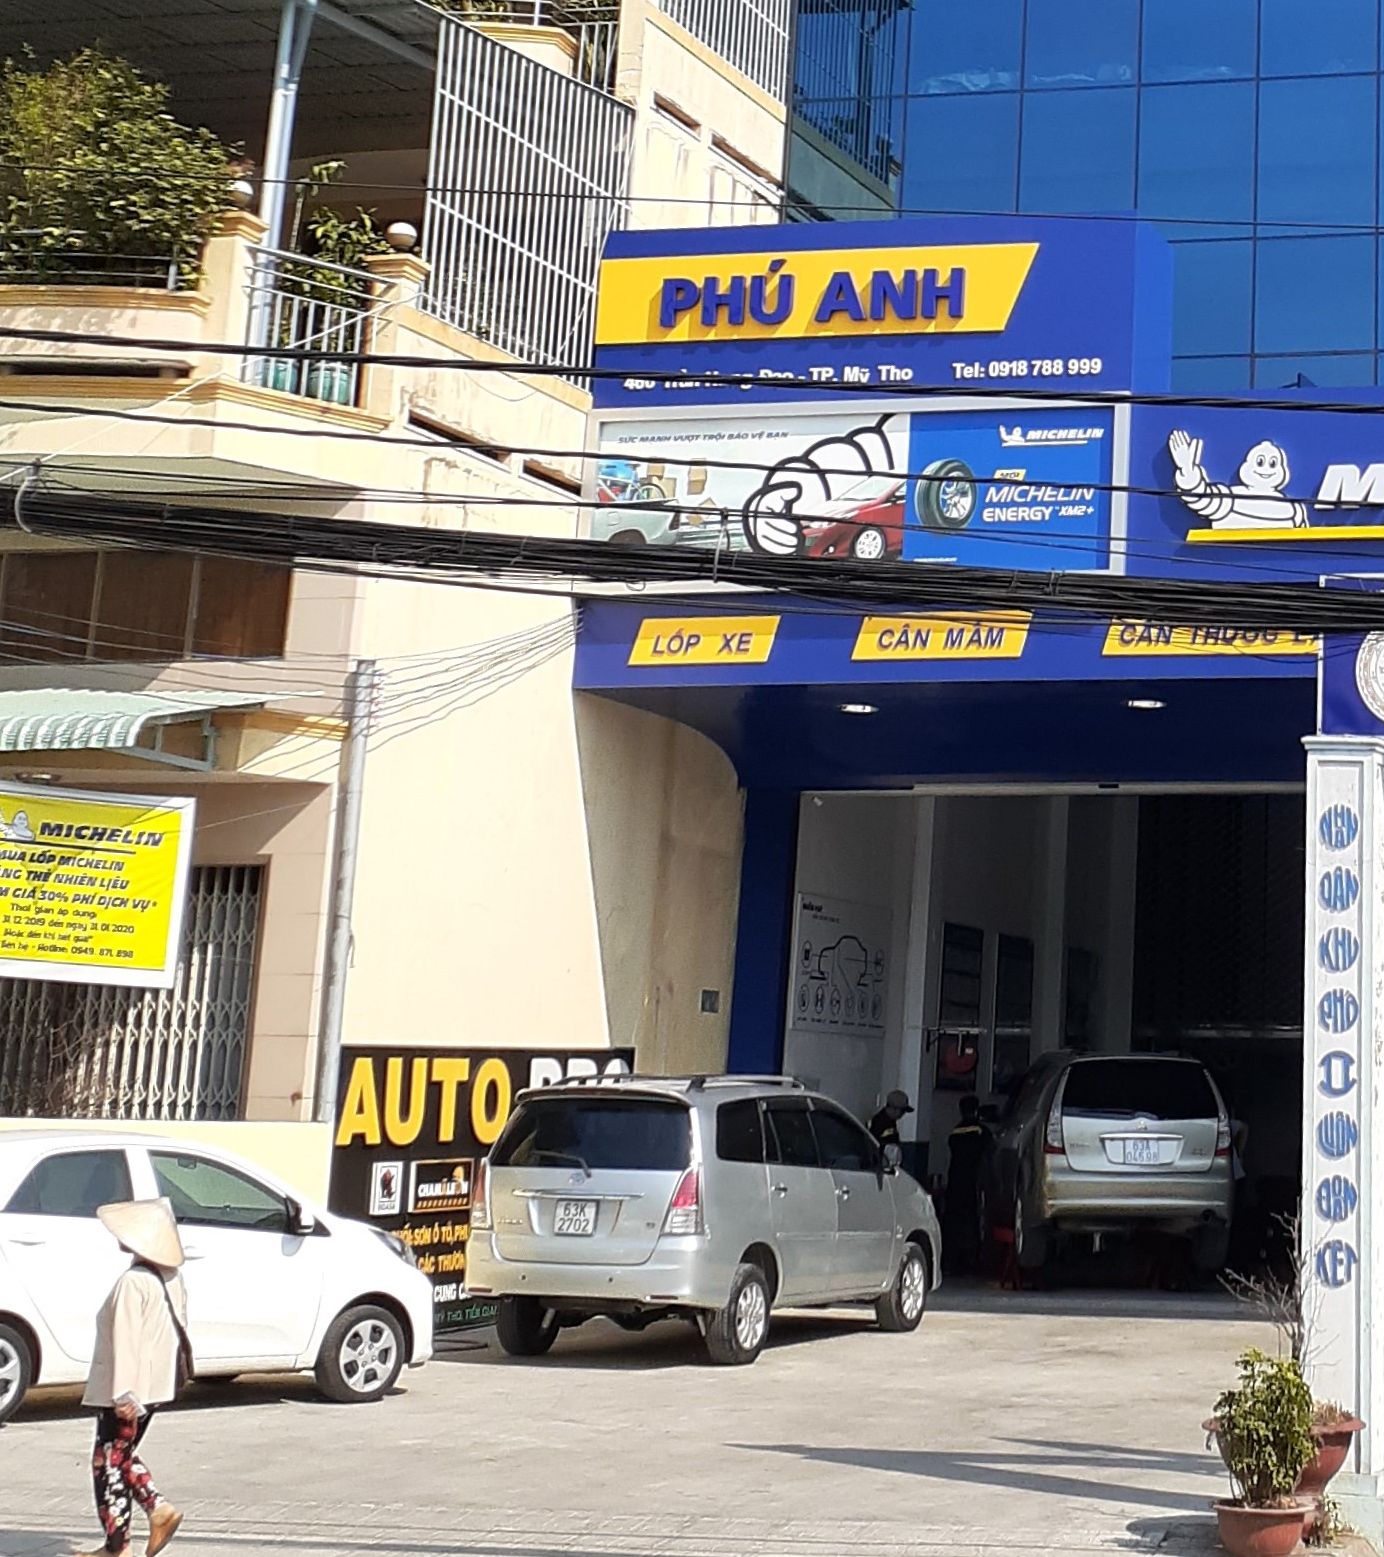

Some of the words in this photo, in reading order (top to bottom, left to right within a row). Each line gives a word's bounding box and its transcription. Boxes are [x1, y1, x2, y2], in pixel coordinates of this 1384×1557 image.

[660, 259, 794, 327] PHÚ
[815, 267, 965, 322] ANH
[809, 366, 838, 382] TP.
[843, 365, 869, 384] Mỹ
[877, 365, 913, 382] Tho
[952, 362, 985, 380] Tel:
[988, 360, 1028, 378] 0918
[1031, 359, 1065, 376] 788
[1068, 357, 1102, 375] 999
[1026, 428, 1104, 440] MICHELIN
[985, 484, 1095, 503] MICHELIN
[982, 505, 1051, 522] ENERGY
[652, 627, 701, 655] LỐP
[717, 632, 753, 654] XE
[876, 625, 931, 651] CÂN
[943, 621, 1005, 650] MÂM
[39, 822, 165, 846] MICHELIN
[28, 849, 56, 864] LỐP
[58, 855, 125, 872] MICHELIN
[0, 865, 22, 880] NG
[26, 867, 52, 882] THẺ
[54, 872, 97, 887] NHIÊN
[100, 875, 130, 891] LIỆU
[12, 885, 37, 899] GIÁ
[38, 890, 69, 903] 30%
[71, 891, 96, 904] PHÍ
[97, 895, 129, 910] DỊCH
[334, 1056, 511, 1146] AUTO
[563, 1202, 586, 1218] 63K
[557, 1217, 590, 1232] 2702
[433, 1283, 457, 1302] CUNG
